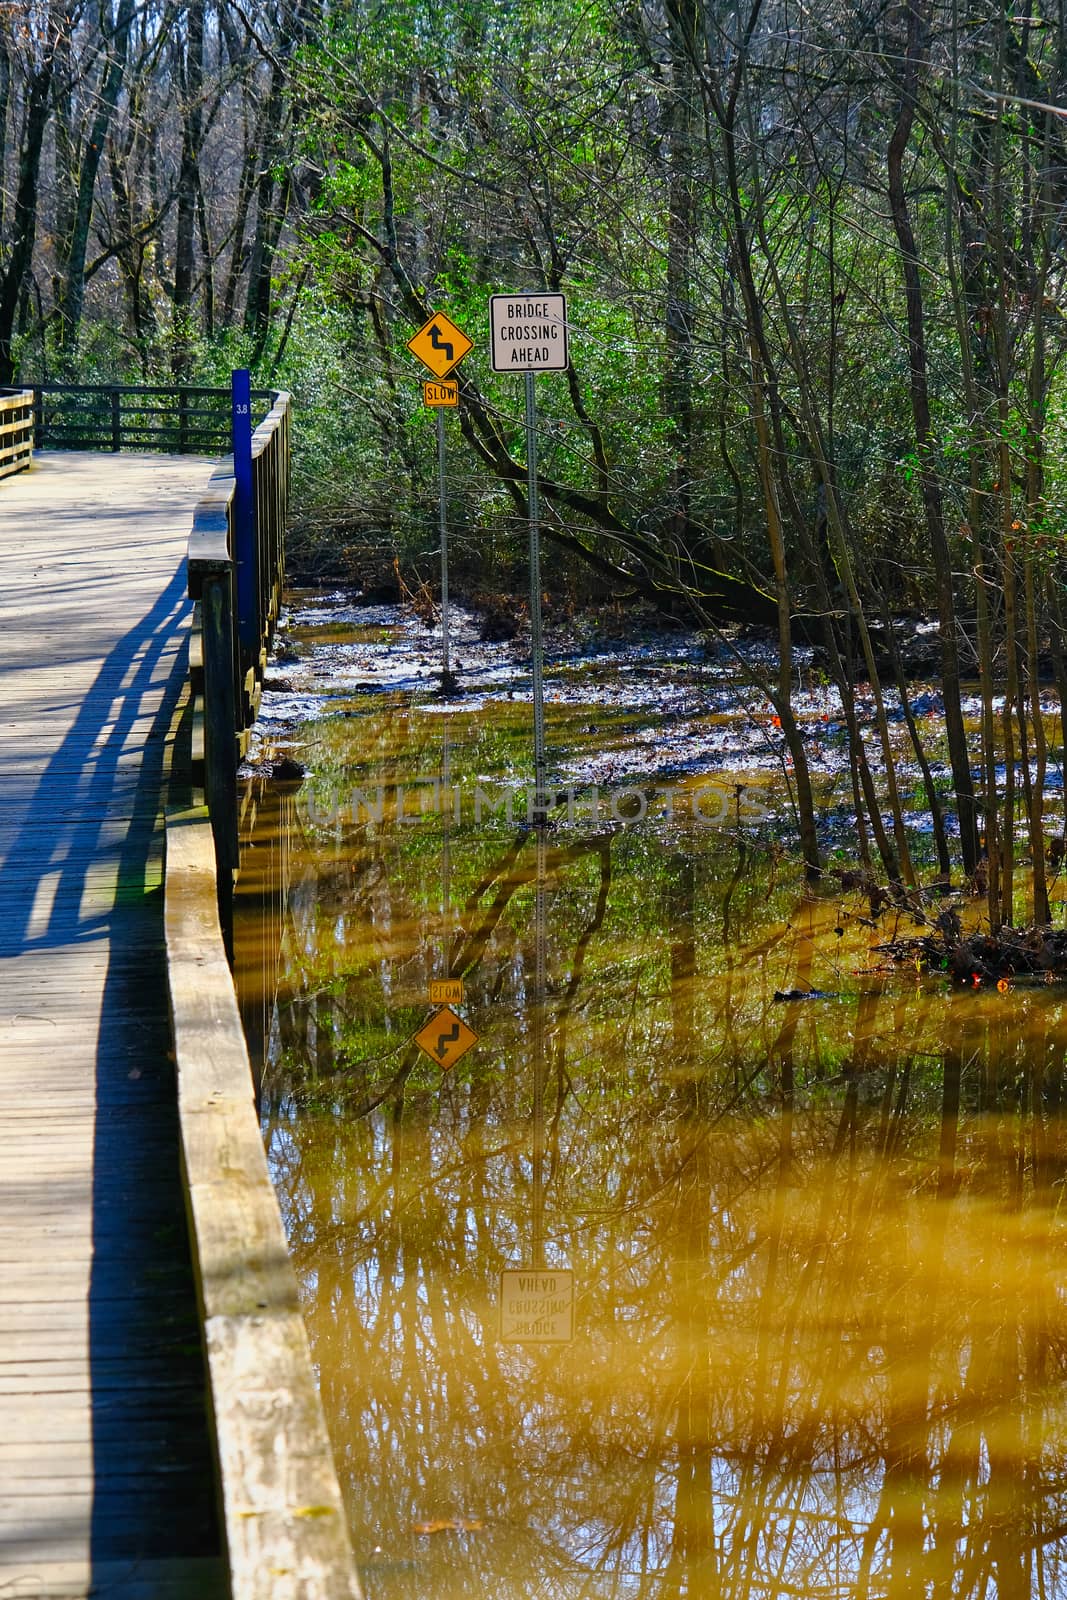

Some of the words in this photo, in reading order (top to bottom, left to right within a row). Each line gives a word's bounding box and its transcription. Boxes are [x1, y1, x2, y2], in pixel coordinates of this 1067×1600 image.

[508, 303, 549, 318] BRIDGE
[500, 324, 558, 341] CROSSING
[511, 347, 549, 362] AHEAD
[427, 387, 455, 400] SLOW
[236, 404, 248, 414] 3.8
